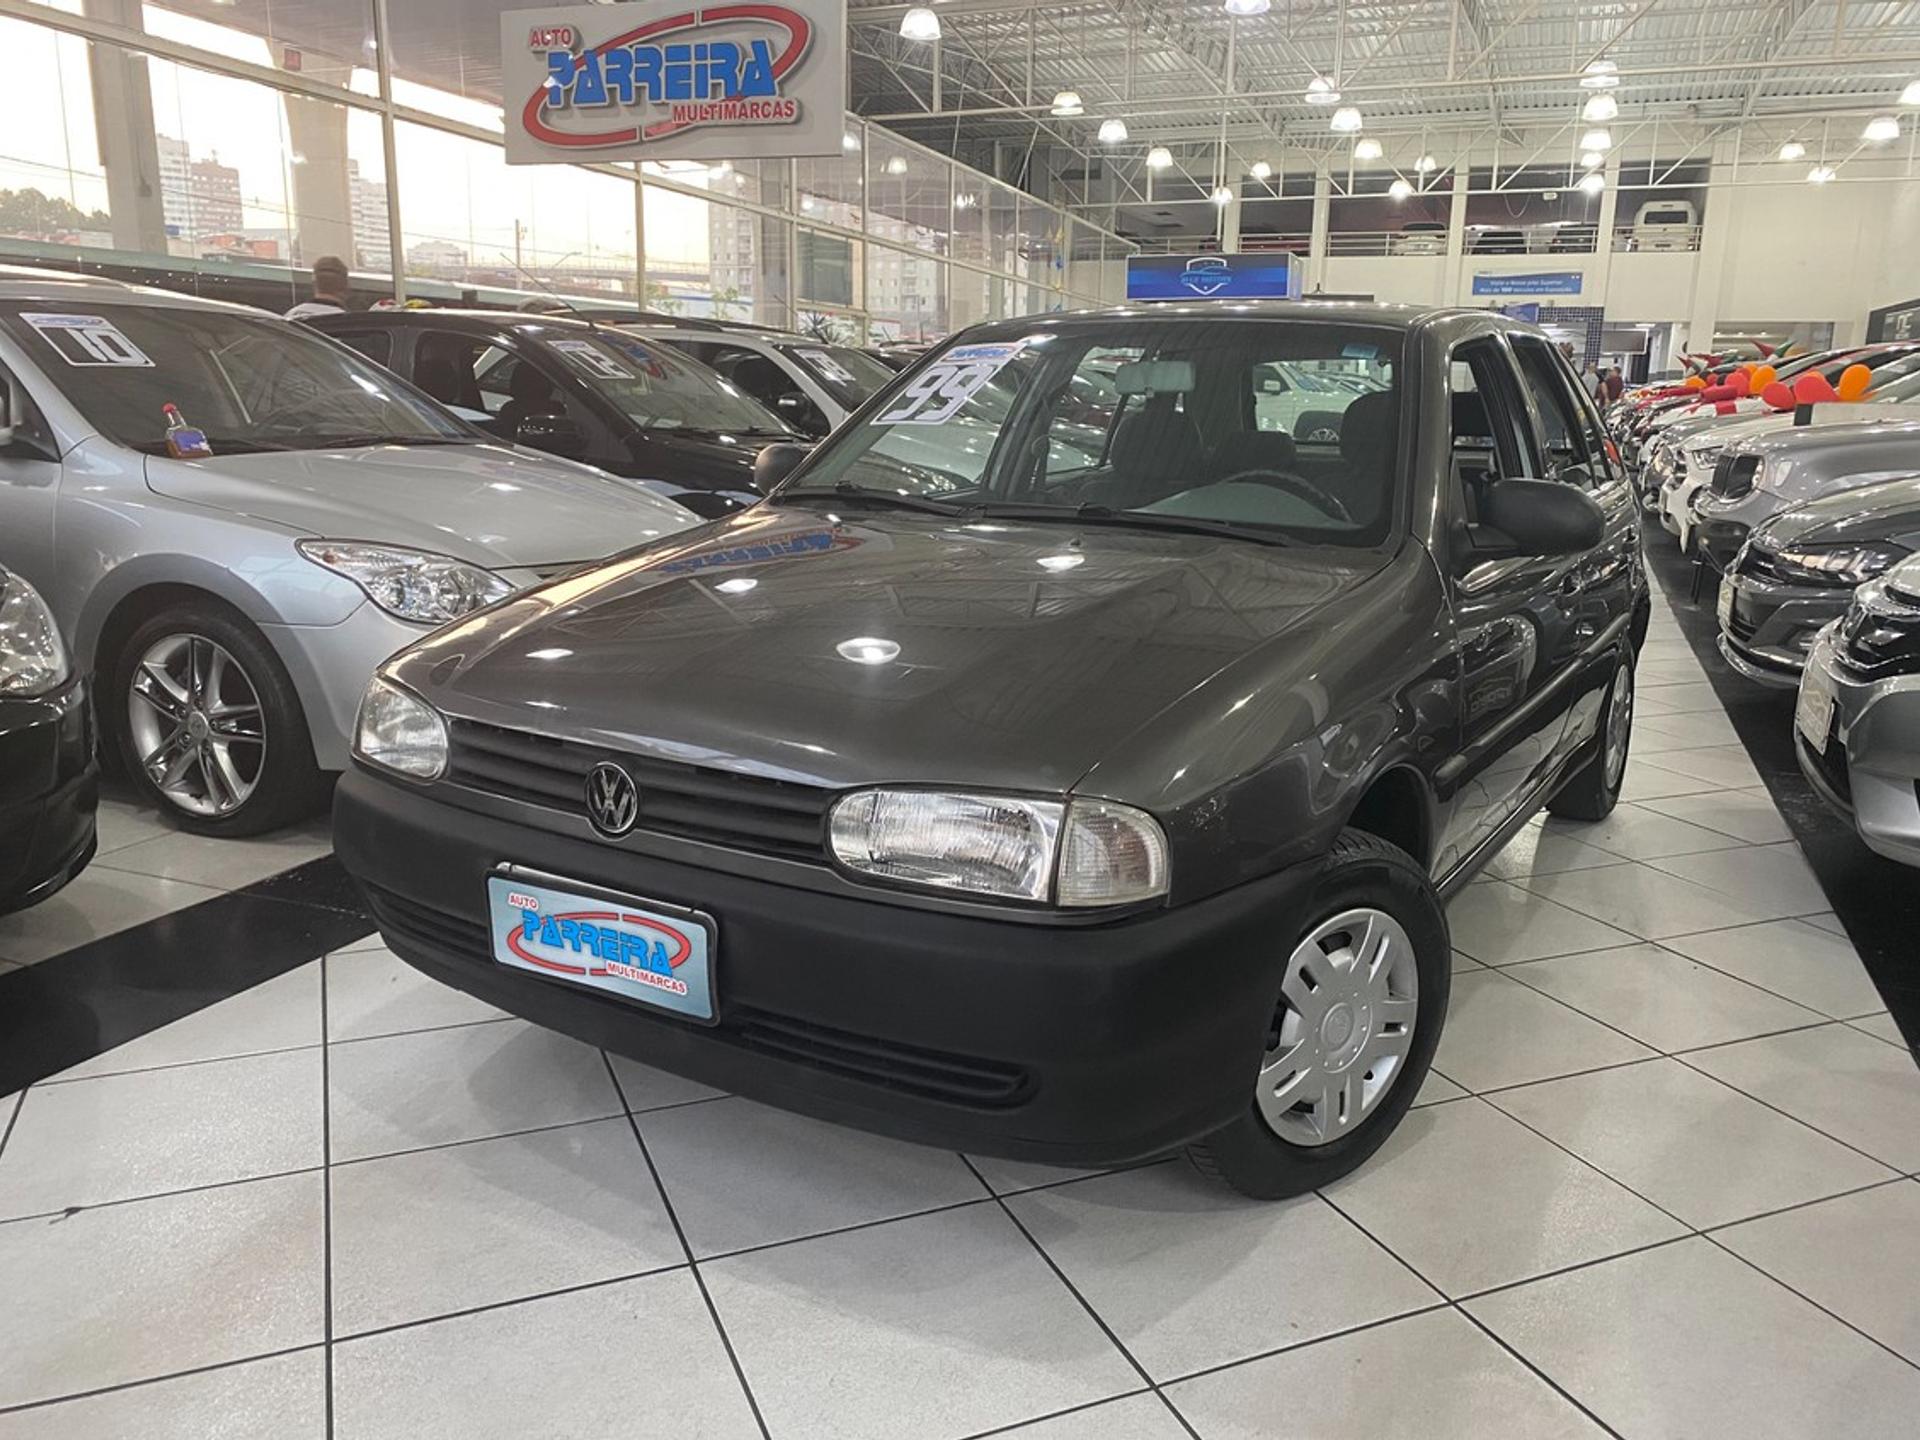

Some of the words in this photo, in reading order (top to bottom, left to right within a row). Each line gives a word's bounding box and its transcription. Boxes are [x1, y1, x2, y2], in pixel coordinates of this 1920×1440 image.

[530, 28, 573, 46] AUTO
[547, 39, 778, 106] PARREIRA
[673, 100, 795, 123] MULTIMARCAS
[880, 364, 995, 421] 99
[510, 893, 538, 909] AUTO
[521, 910, 673, 977] PARREIRA
[607, 962, 686, 993] MULTIMARCAS
